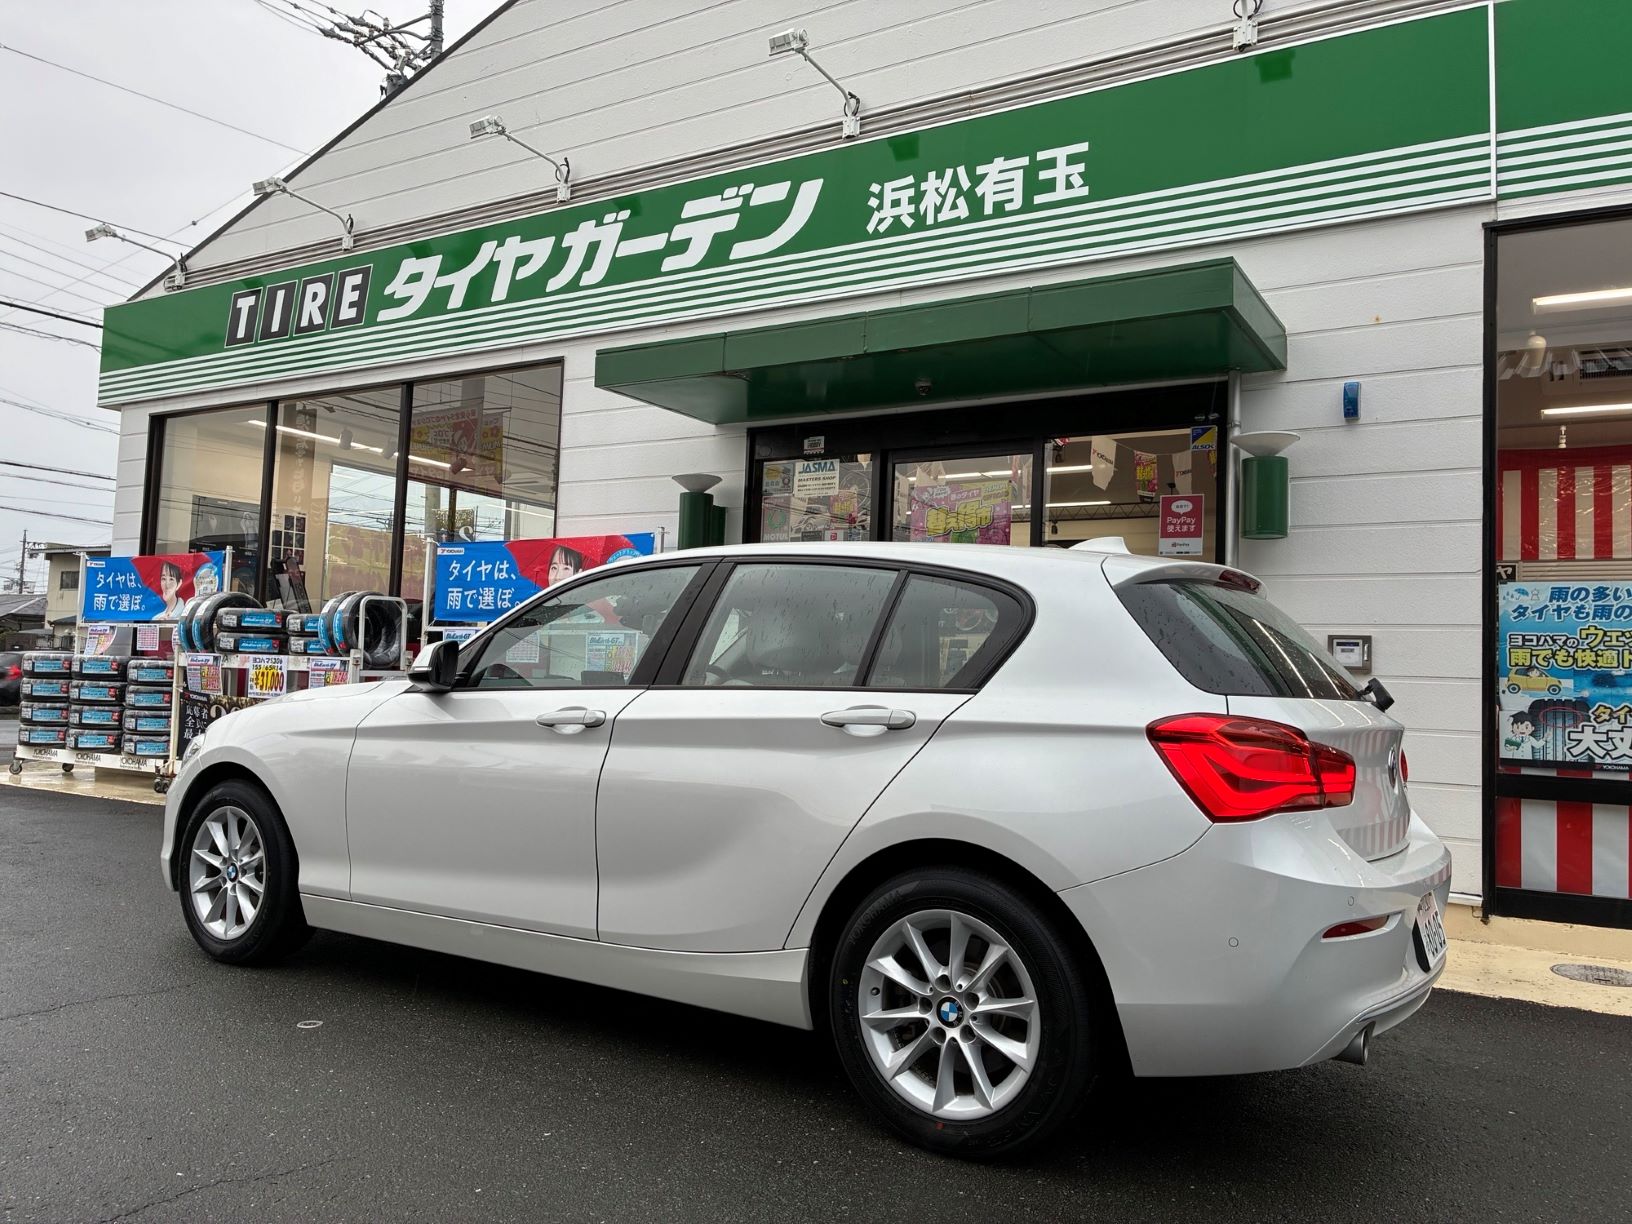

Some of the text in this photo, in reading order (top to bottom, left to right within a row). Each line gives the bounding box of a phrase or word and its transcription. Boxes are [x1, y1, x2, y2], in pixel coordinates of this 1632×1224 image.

[866, 141, 1089, 234] 浜松有玉
[236, 178, 824, 339] TIRE タイヤガーデン
[798, 461, 836, 474] JASMA
[1167, 517, 1196, 525] PayPay
[764, 533, 789, 541] MOTUL
[449, 560, 517, 581] タイヤは、
[96, 571, 142, 589] タイヤは、
[94, 594, 146, 611] 雨で選ぼ。
[447, 587, 520, 609] 雨で選ぼ。
[1549, 586, 1632, 603] 雨の多い
[1511, 604, 1632, 621] タイヤも雨の
[255, 671, 285, 692] ¥31,000
[1592, 704, 1632, 725] タイ
[34, 748, 58, 758] YOKOHAMA
[76, 752, 101, 762] YOKOHAMA
